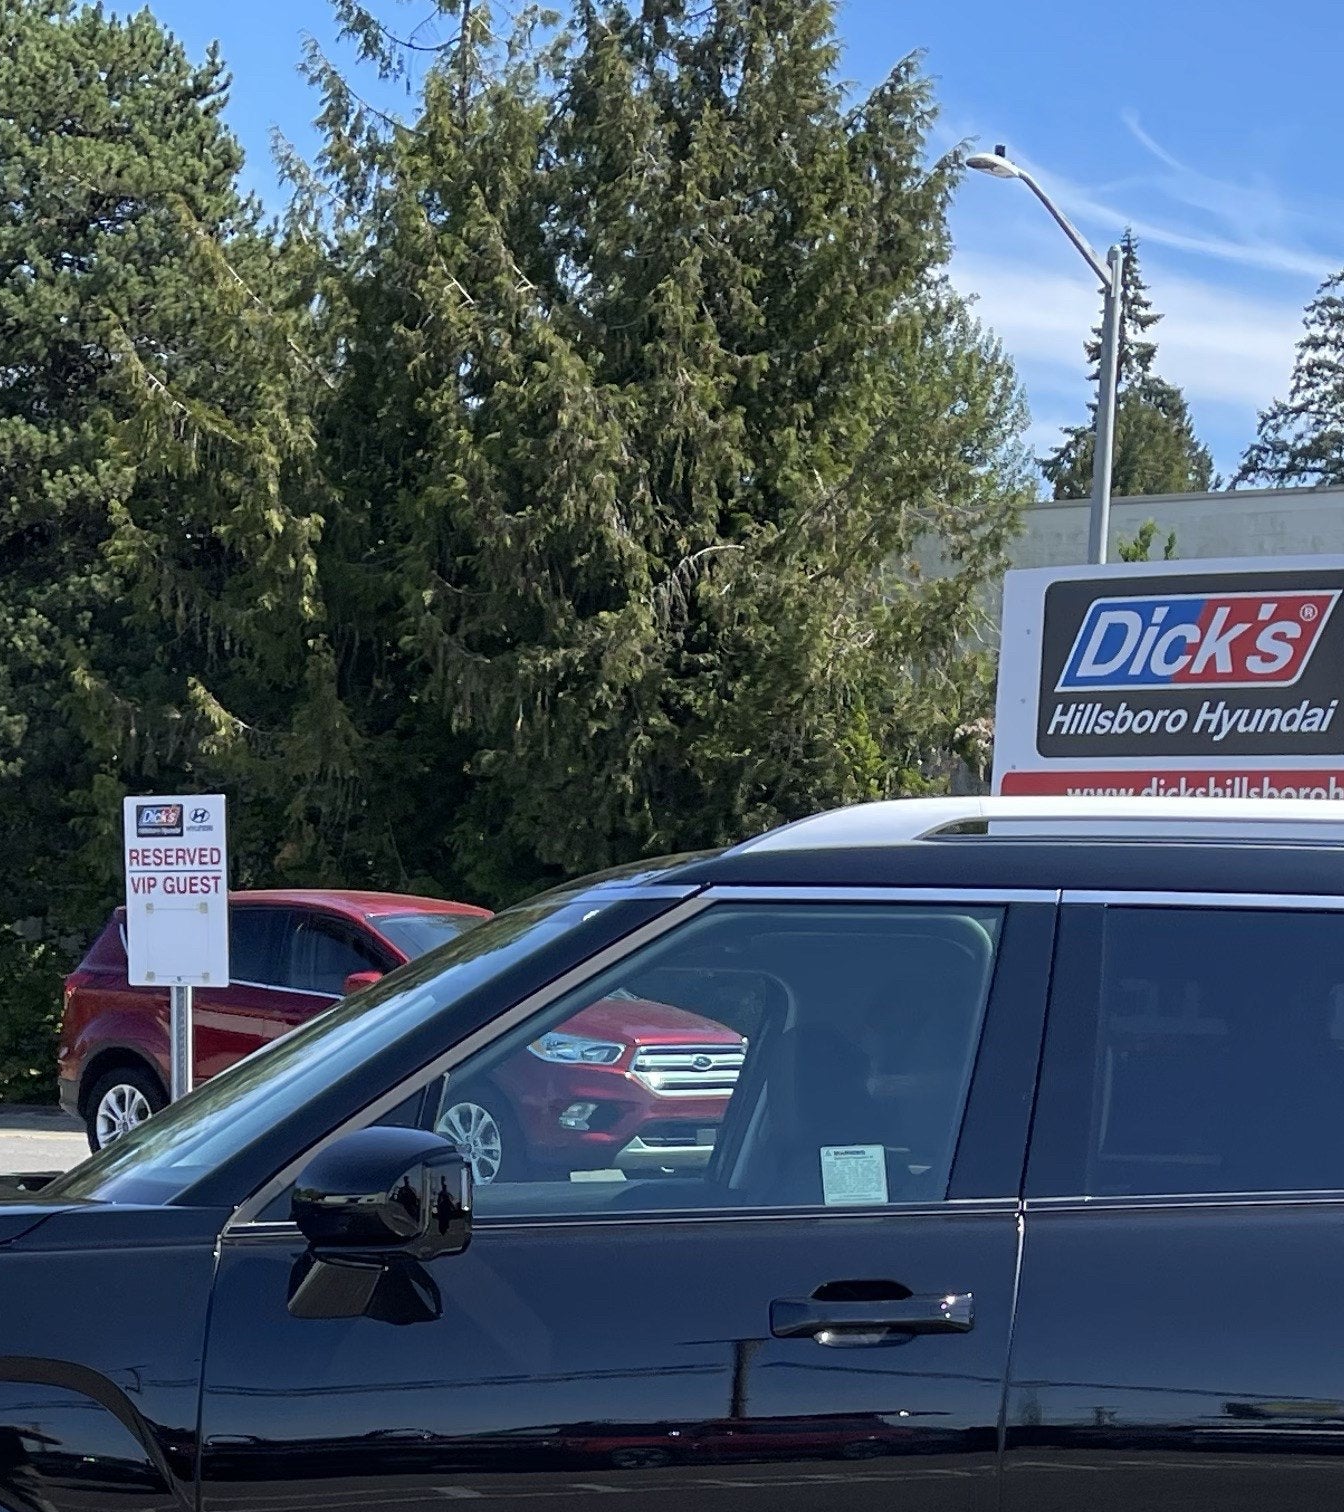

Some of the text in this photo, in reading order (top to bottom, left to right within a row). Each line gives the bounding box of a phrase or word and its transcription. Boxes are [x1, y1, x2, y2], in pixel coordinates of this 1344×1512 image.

[1047, 699, 1339, 741] Hillsboro Hyundai
[129, 847, 221, 867] RESERVED
[131, 876, 221, 894] VIP GUEST
